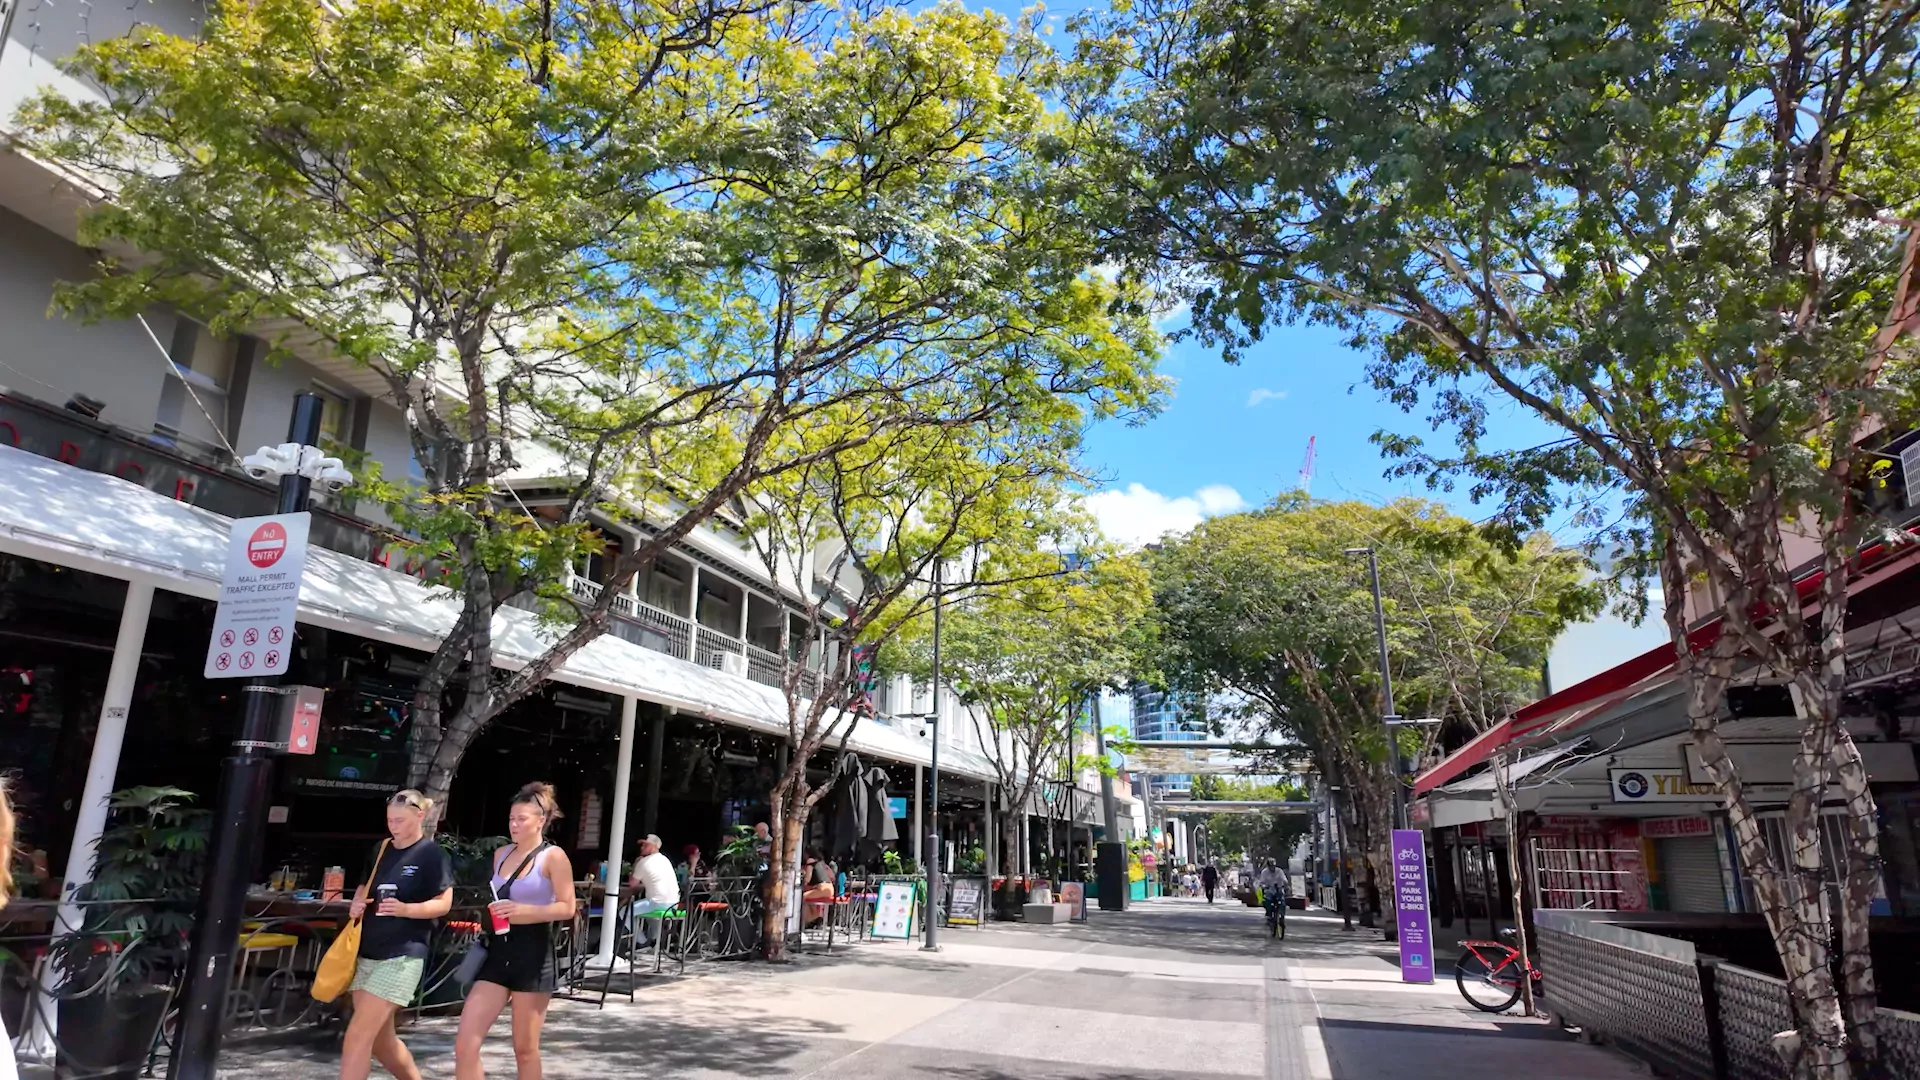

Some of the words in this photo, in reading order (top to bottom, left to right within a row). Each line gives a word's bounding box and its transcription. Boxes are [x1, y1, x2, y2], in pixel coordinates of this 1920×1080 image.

[263, 529, 275, 539] NO
[252, 550, 280, 561] ENTRY
[238, 574, 258, 583] MALL
[259, 572, 287, 582] PERMIT
[226, 584, 255, 595] TRAFFIC
[257, 582, 296, 593] EXCEPTED
[1399, 864, 1419, 872] KEEP
[1399, 872, 1421, 880] CALM
[1401, 886, 1422, 894] PARK
